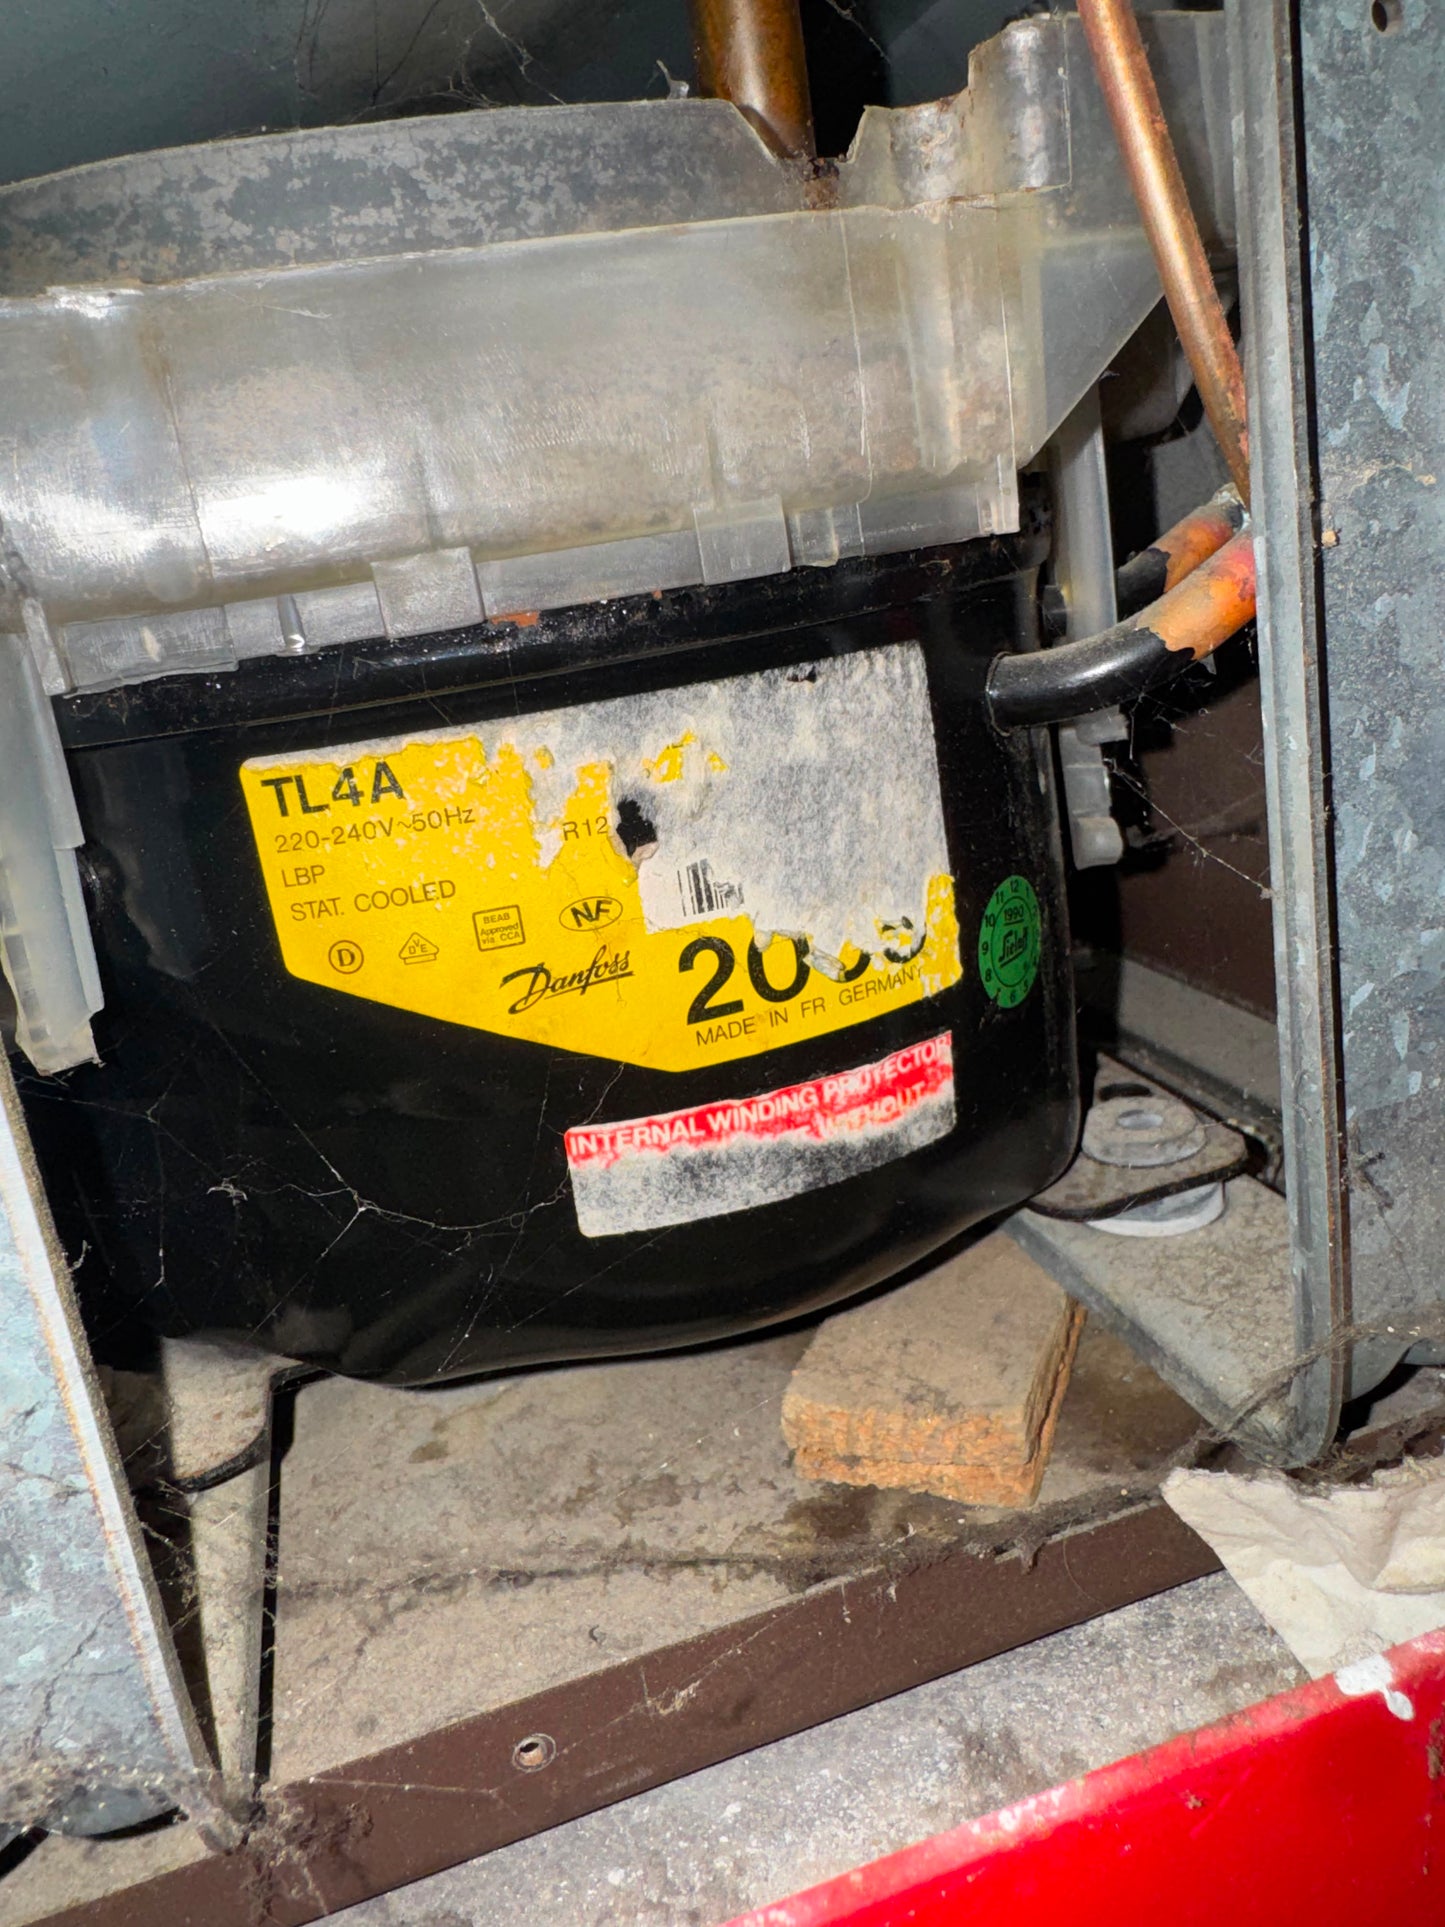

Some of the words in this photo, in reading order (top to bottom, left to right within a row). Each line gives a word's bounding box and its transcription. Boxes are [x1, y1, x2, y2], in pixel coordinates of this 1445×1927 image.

[261, 761, 405, 817] TL4A
[562, 816, 609, 841] R12
[281, 864, 326, 888] LBP
[290, 897, 345, 922] STAT.
[354, 880, 456, 912] COOLED
[570, 899, 612, 928] NF
[499, 931, 520, 942] CCA
[499, 944, 634, 1015] Danfoss
[695, 1016, 756, 1047] MADE
[769, 1007, 789, 1028] IN
[800, 996, 826, 1019] FR
[838, 965, 924, 1006] GERMANY
[569, 1117, 706, 1157] INTERNAL
[706, 1087, 817, 1133] WINDING
[822, 1035, 951, 1103] PROTECTOR
